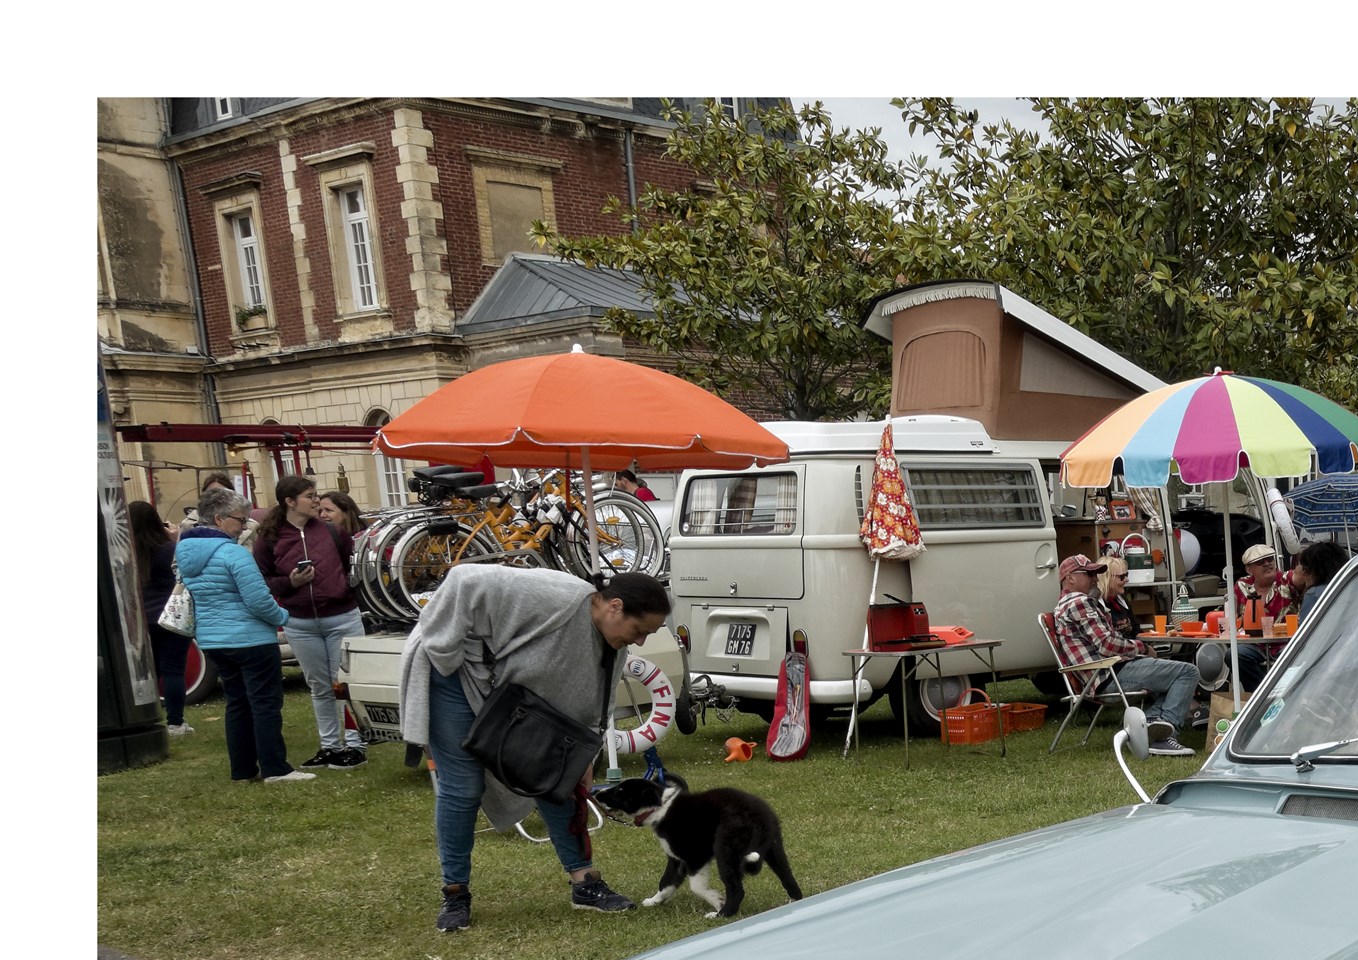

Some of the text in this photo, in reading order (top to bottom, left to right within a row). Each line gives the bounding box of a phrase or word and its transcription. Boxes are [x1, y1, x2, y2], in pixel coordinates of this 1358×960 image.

[730, 624, 752, 639] 7175
[727, 640, 751, 654] GM 76
[639, 685, 672, 743] FINA
